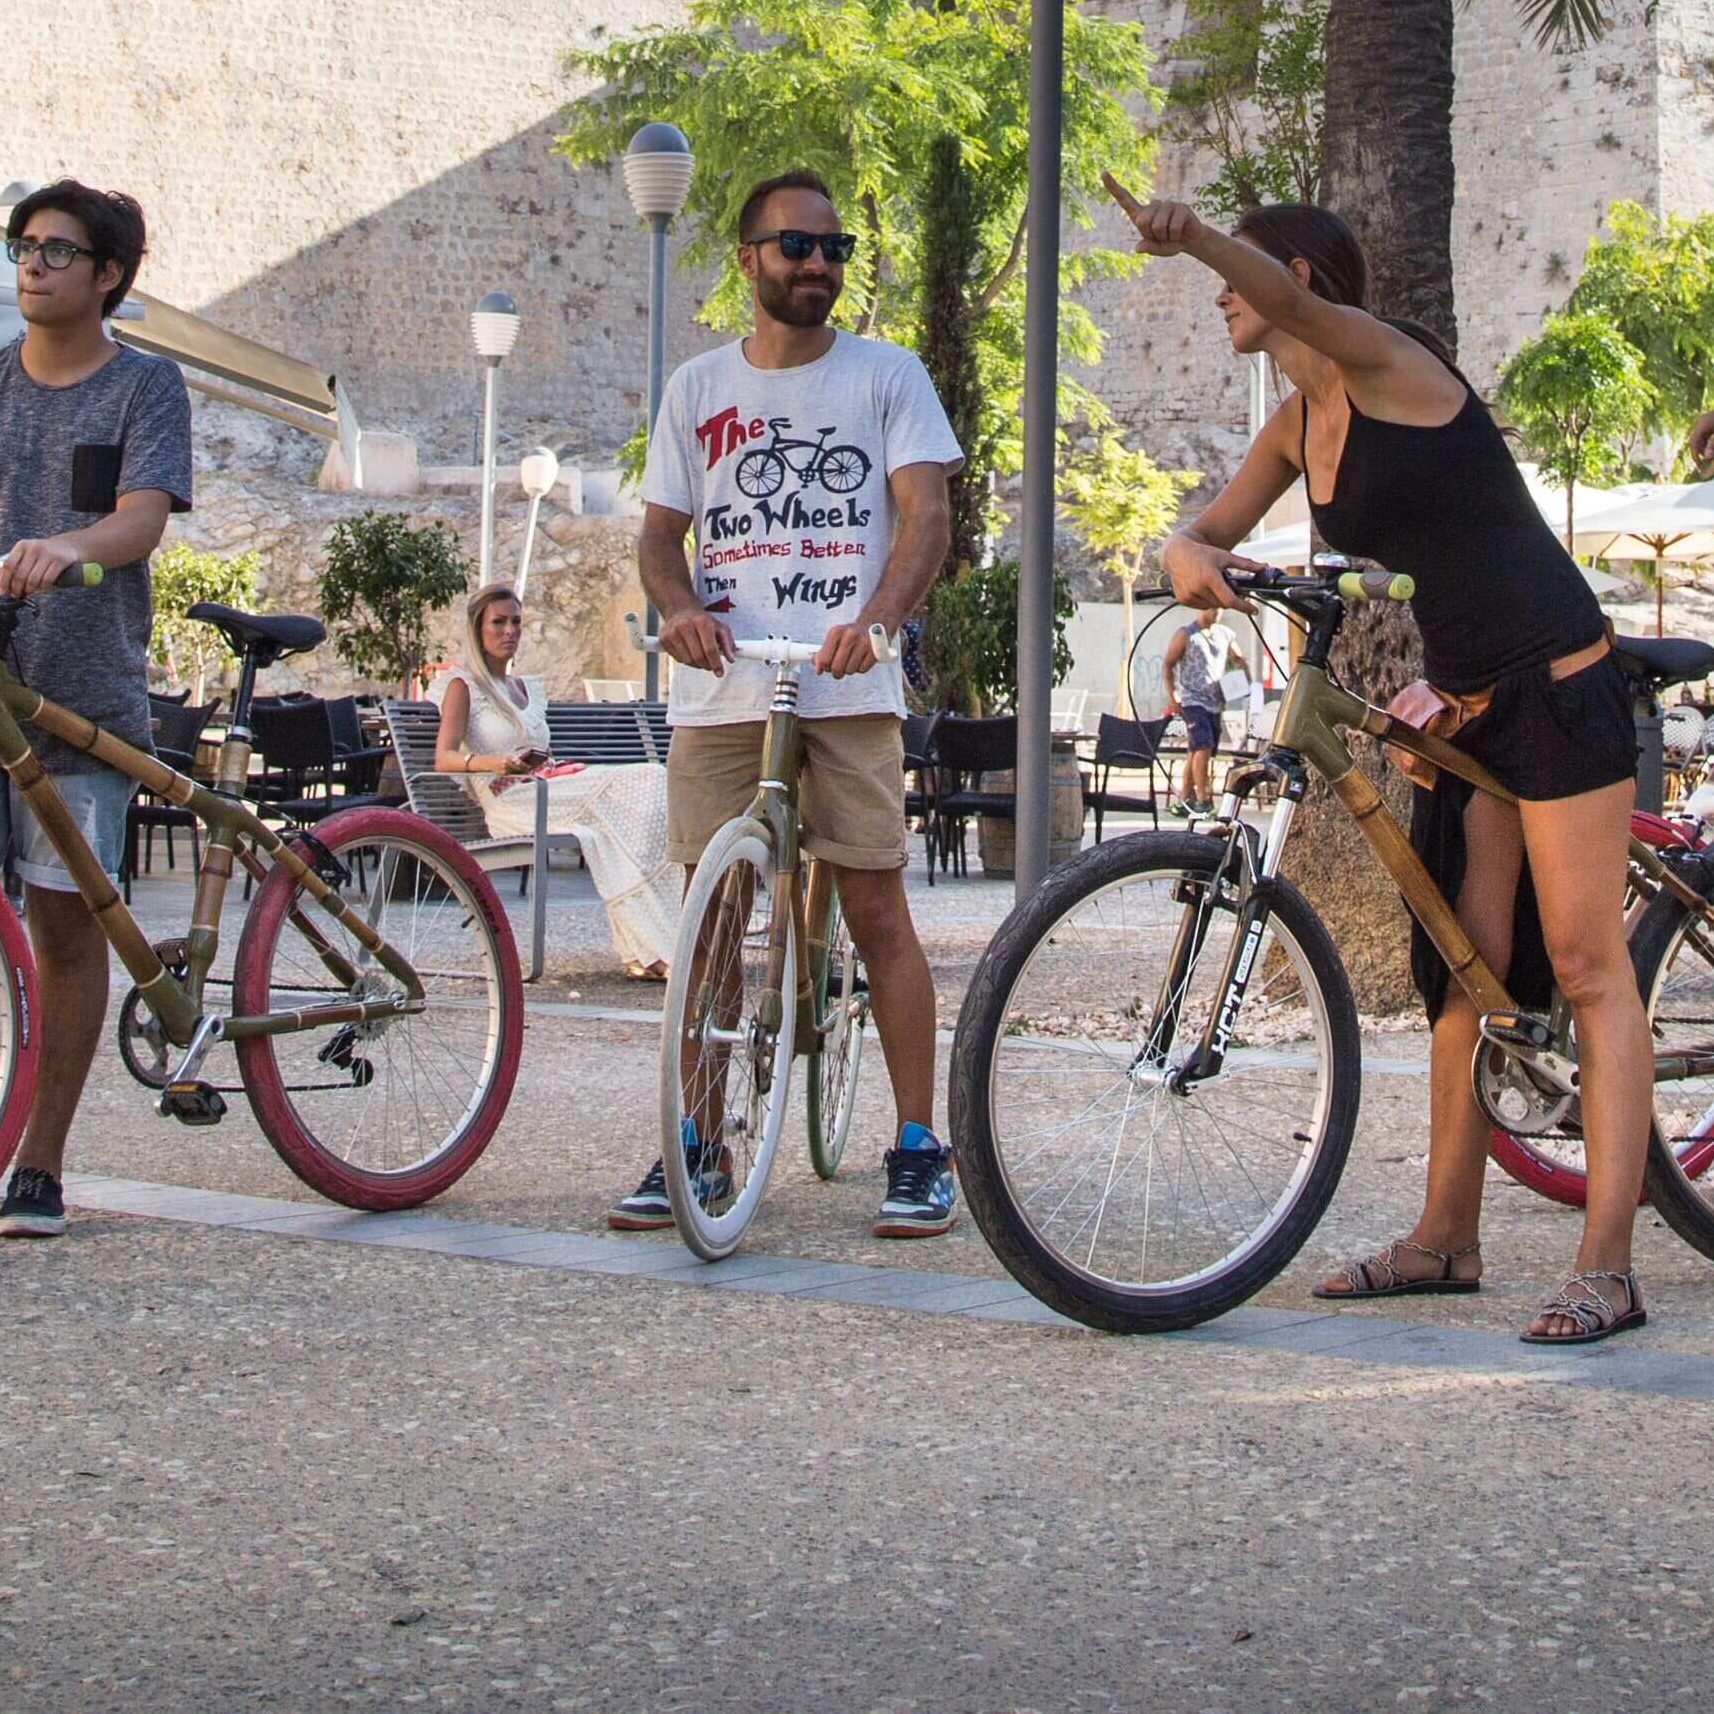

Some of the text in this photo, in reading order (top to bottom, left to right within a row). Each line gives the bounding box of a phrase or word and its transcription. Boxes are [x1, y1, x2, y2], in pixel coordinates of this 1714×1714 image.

[695, 405, 765, 472] The
[704, 490, 872, 541] Two Wheels
[702, 540, 792, 569] Sometimes
[704, 572, 857, 610] Then Wings
[1211, 983, 1241, 1056] XCT
